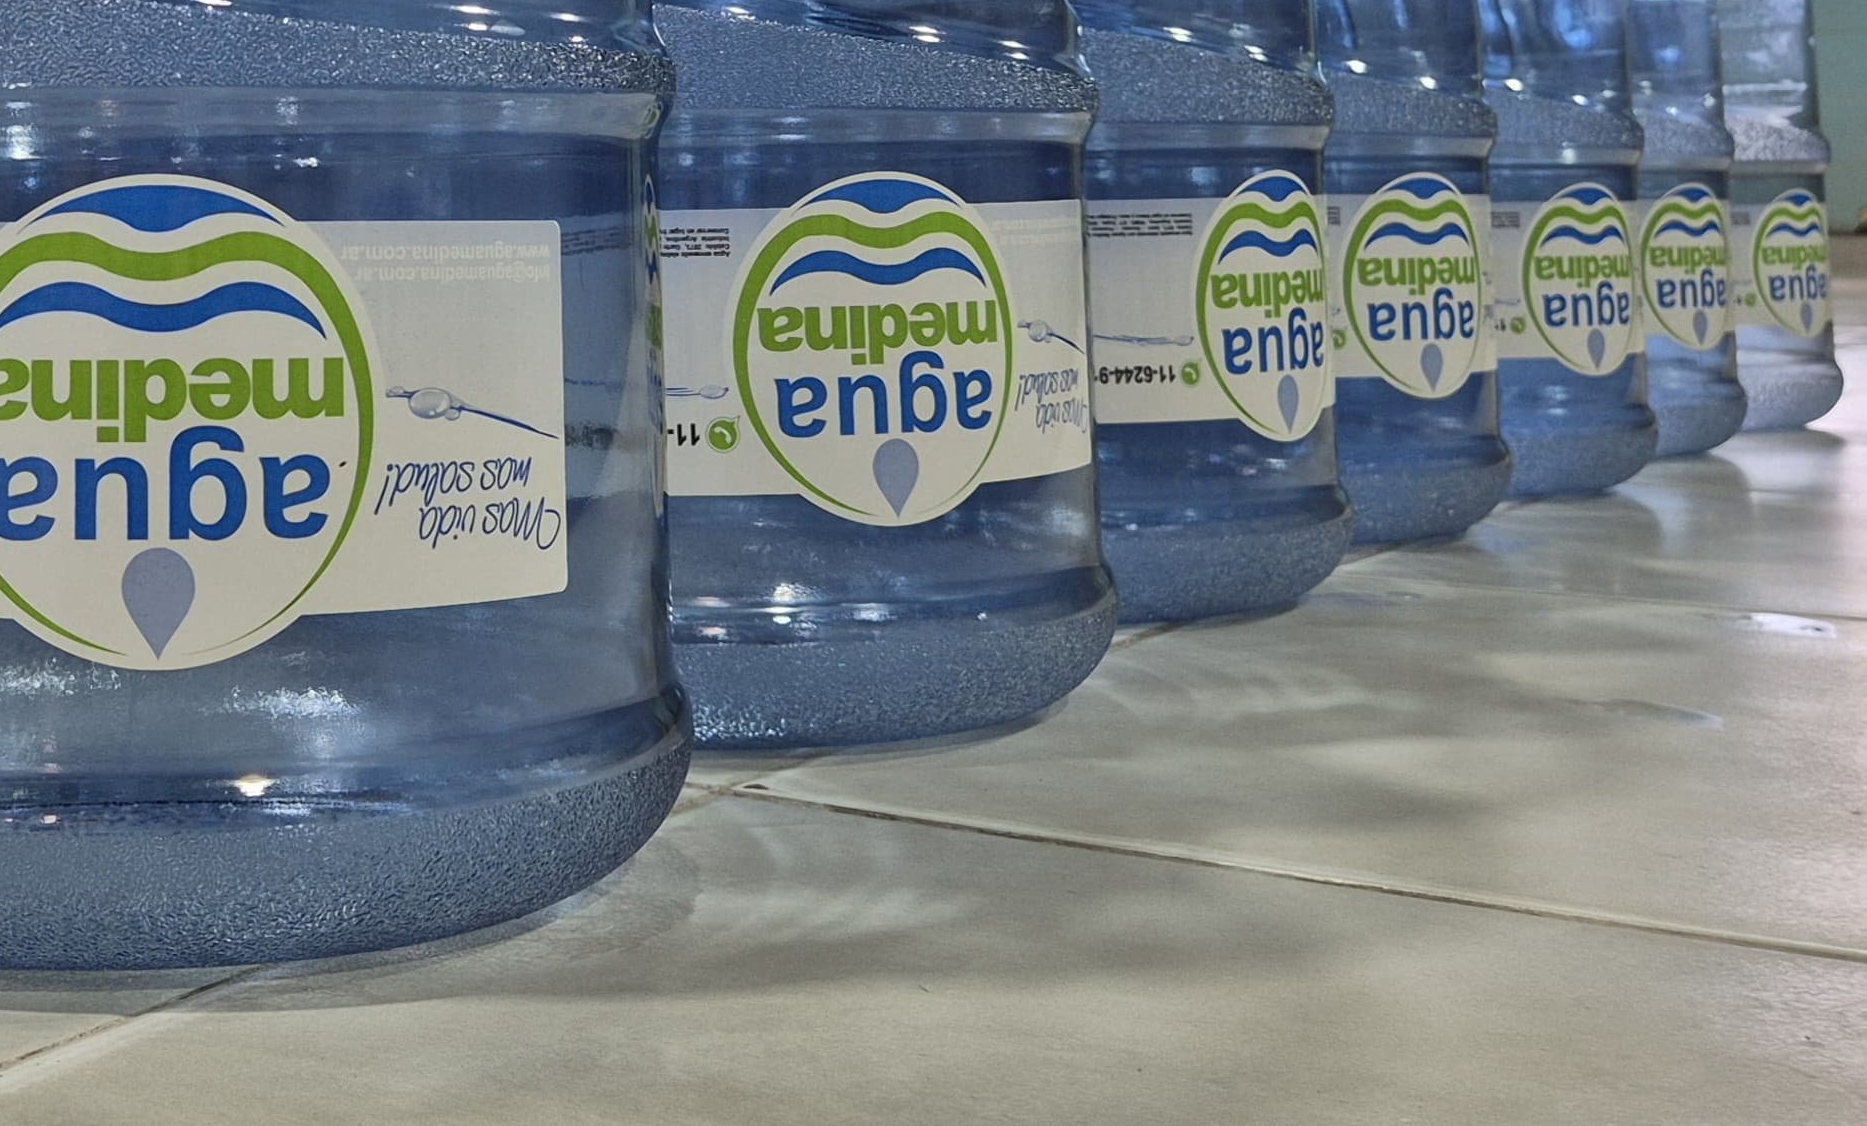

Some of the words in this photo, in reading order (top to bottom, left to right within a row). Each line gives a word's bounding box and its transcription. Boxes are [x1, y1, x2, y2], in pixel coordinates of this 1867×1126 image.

[1357, 256, 1475, 296] medina
[1534, 256, 1630, 288] medina
[1650, 246, 1727, 275] medina
[1768, 264, 1827, 303] agua
[1210, 269, 1324, 318] medina
[1542, 281, 1630, 328] agua
[1656, 268, 1727, 309] agua
[756, 300, 998, 365] medina
[1367, 287, 1475, 342] agua
[1221, 308, 1324, 376] agua
[774, 351, 993, 438] agua
[374, 461, 475, 515] salud!
[480, 457, 532, 490] mas
[419, 505, 476, 549] vida
[482, 497, 561, 550] Mas
